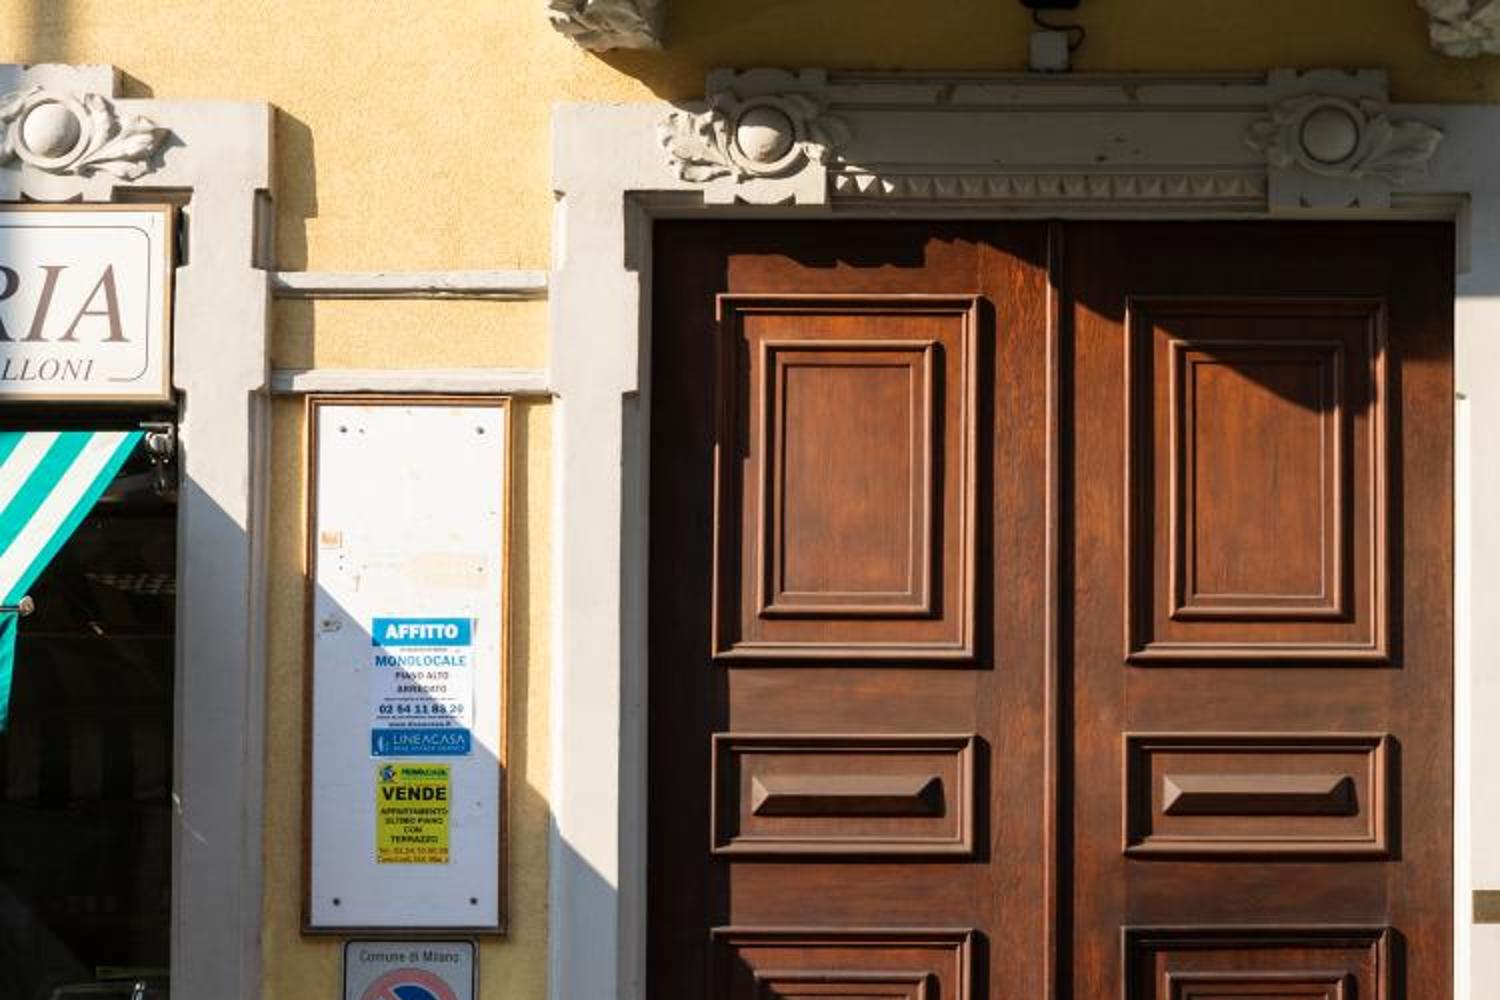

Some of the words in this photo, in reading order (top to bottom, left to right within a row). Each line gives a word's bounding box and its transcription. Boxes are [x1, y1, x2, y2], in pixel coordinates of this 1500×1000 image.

[385, 623, 459, 640] AFFITTO
[375, 655, 466, 667] MONOLOCALE
[379, 704, 393, 714] 02
[414, 704, 428, 714] 11
[393, 734, 465, 745] LINEACASA
[382, 786, 447, 801] VENDE
[359, 950, 405, 963] Comune
[409, 950, 420, 963] di
[423, 950, 459, 963] Milano
